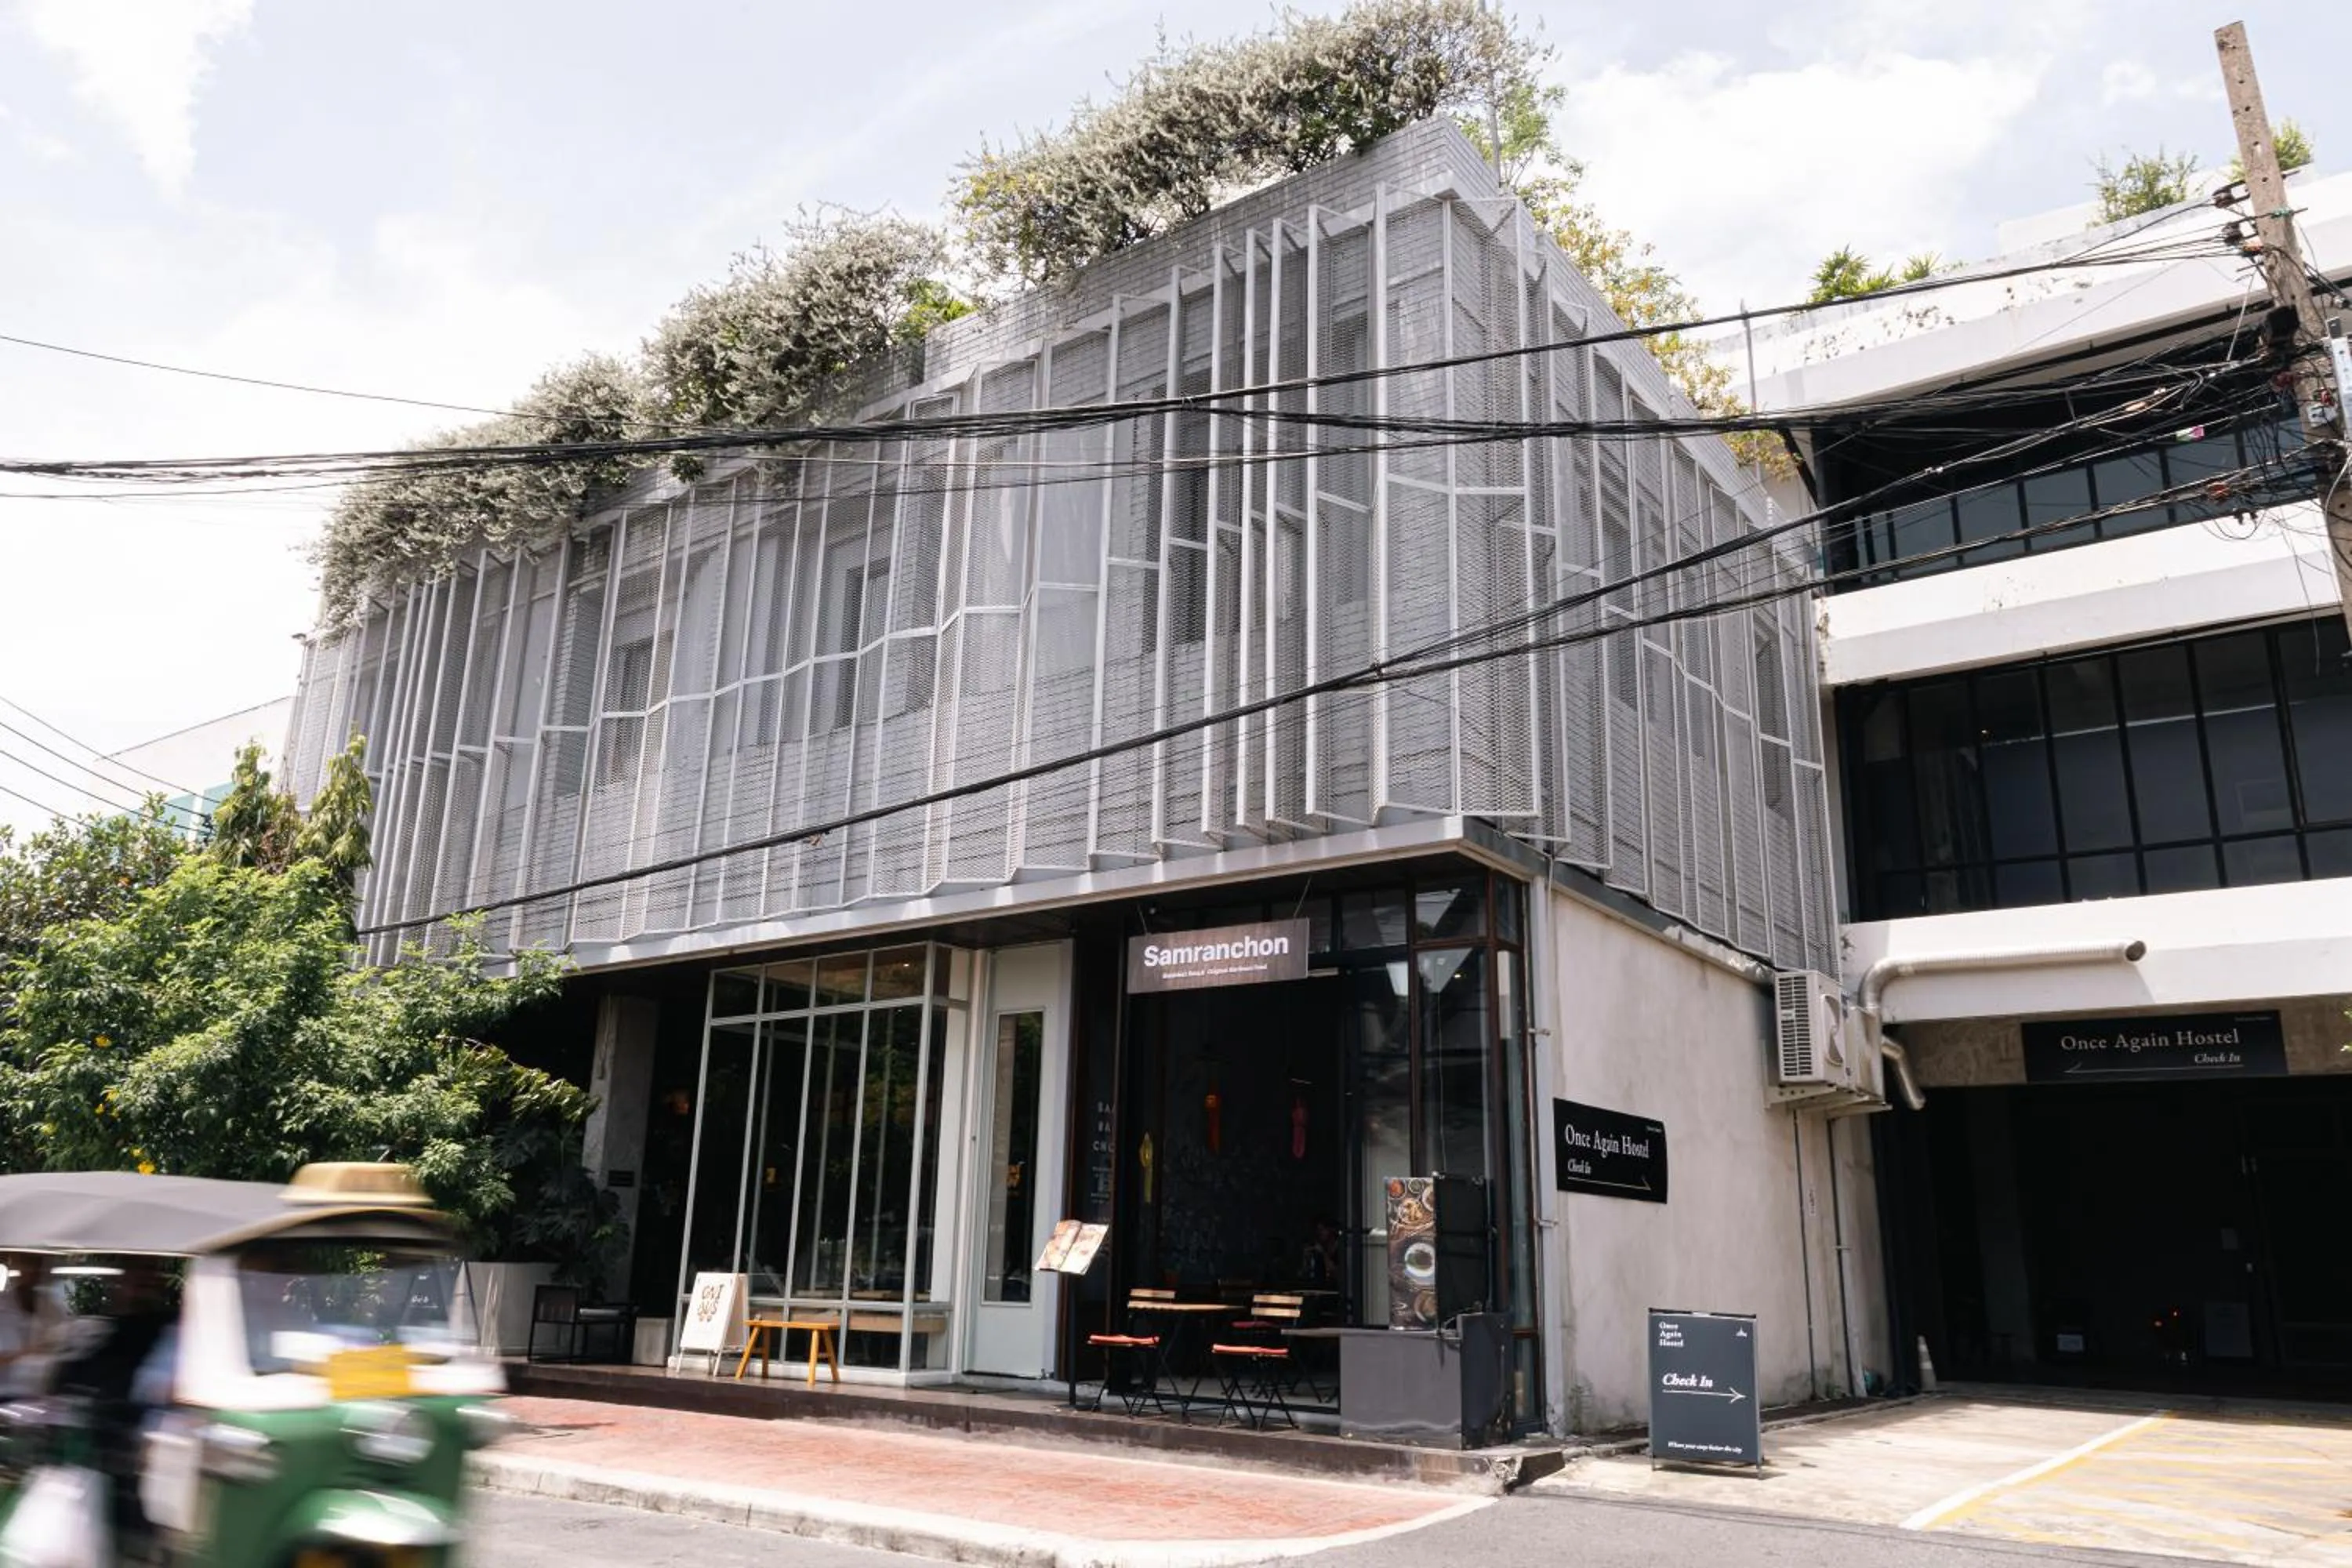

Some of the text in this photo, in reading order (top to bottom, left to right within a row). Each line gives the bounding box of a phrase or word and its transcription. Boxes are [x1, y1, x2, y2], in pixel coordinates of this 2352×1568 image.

[1144, 935, 1288, 967] Samranchon
[2060, 1028, 2240, 1053] Once Again Hostel
[2194, 1052, 2241, 1065] Check In
[1565, 1123, 1650, 1160] Once Again Hostel
[1659, 1321, 1679, 1330] Once
[1660, 1330, 1682, 1339] Again
[1659, 1338, 1684, 1347] Hostel
[1662, 1373, 1713, 1388] Check In
